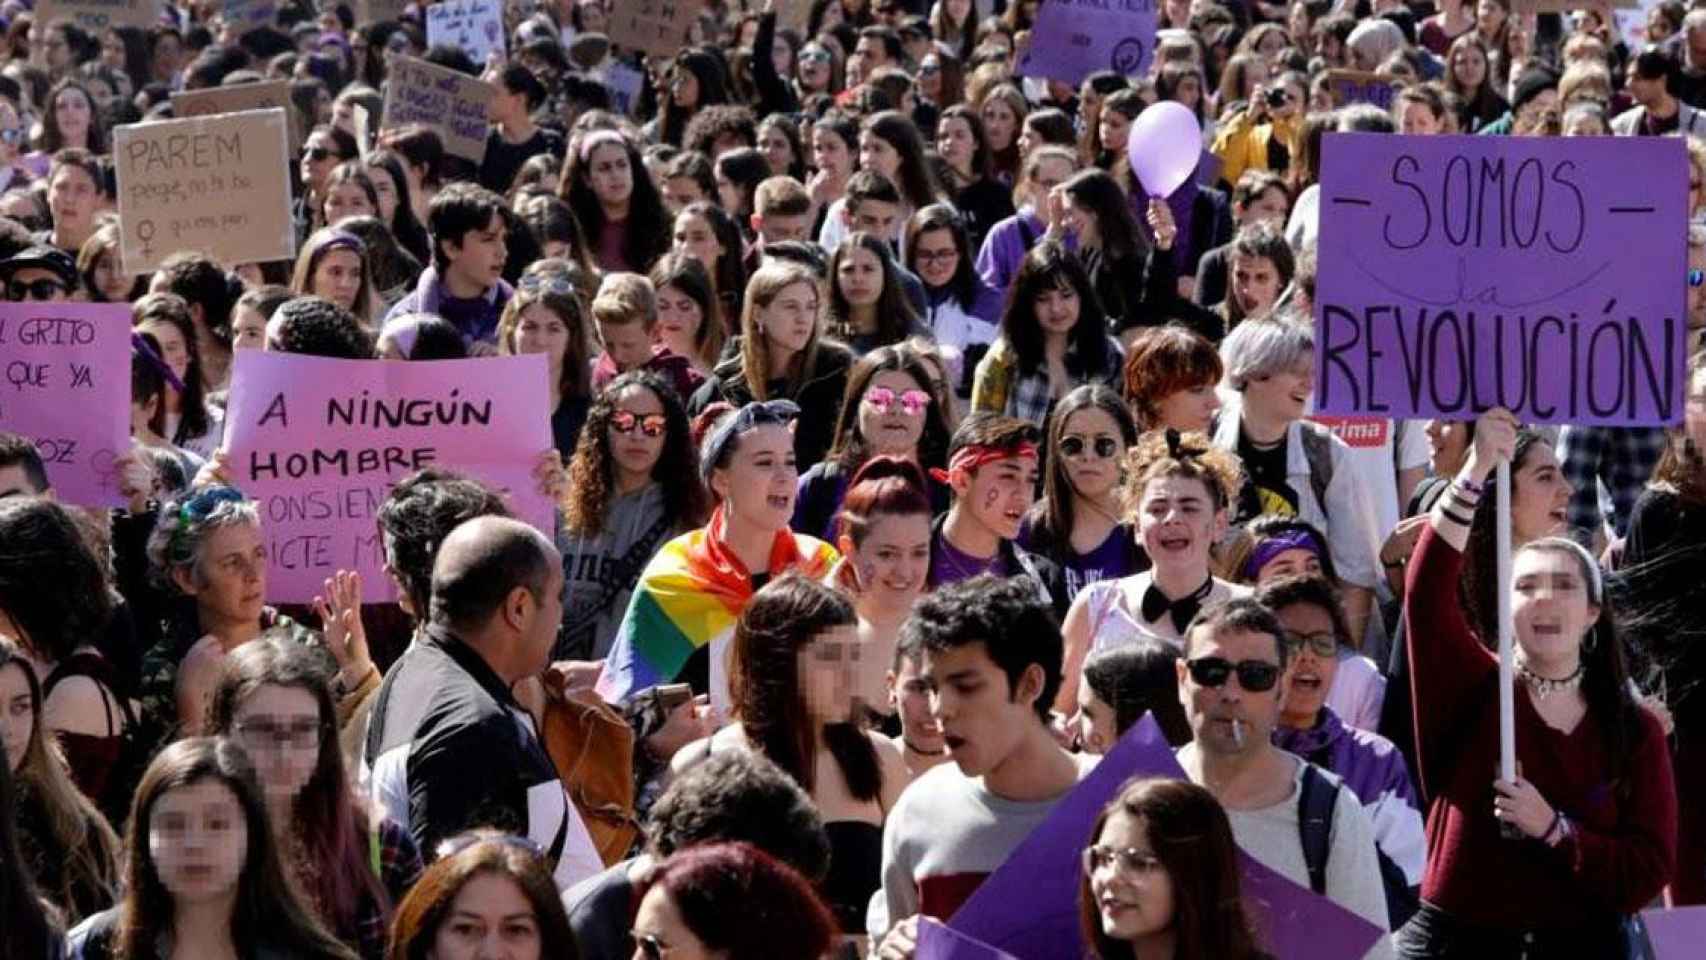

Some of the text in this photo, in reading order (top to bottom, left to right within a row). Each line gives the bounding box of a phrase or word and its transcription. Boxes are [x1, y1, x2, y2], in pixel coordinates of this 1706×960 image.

[127, 131, 243, 174] PAREM
[1383, 155, 1585, 254] SOMOS
[18, 317, 95, 345] GRITO
[6, 360, 93, 391] QUE YA
[258, 391, 287, 428] A
[35, 438, 77, 464] OZ
[250, 446, 436, 480] HOMBRE
[253, 483, 398, 523] ONSIEN
[266, 535, 331, 569] ICTE
